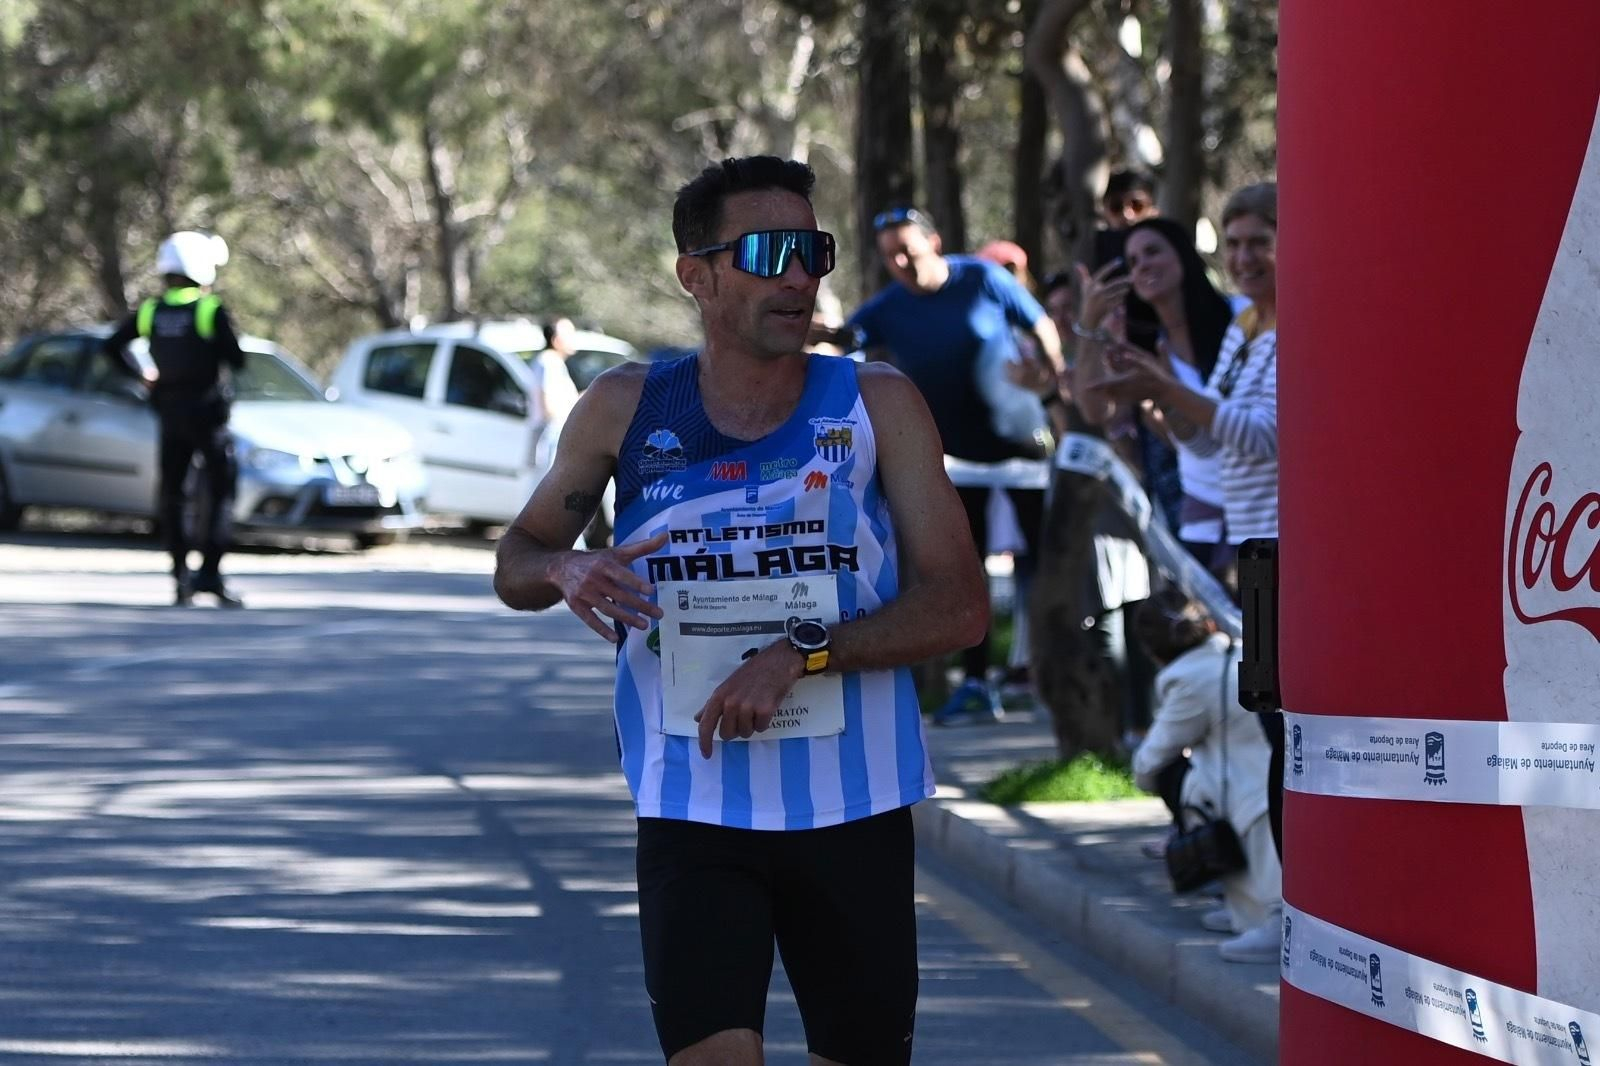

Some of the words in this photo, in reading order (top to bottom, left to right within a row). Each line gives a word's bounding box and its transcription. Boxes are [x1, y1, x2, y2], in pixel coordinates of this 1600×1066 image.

[669, 519, 825, 544] ATLETISMO
[646, 544, 860, 584] MÁLAGA
[692, 594, 739, 604] Ayuntamiento
[741, 594, 751, 602] de
[752, 592, 778, 602] Málaga
[785, 599, 817, 611] Málaga
[691, 624, 762, 634] www.deporte.malaga.eu
[774, 706, 809, 718] RATÓN
[1369, 735, 1394, 746] Deporte
[1396, 737, 1404, 747] de
[1404, 737, 1420, 749] Área
[1541, 741, 1567, 753] Deporte
[1569, 743, 1578, 753] de
[1579, 743, 1595, 756] Área
[1351, 752, 1361, 764] de
[1362, 751, 1420, 766] Ayuntamiento
[1486, 754, 1518, 771] Málaga
[1520, 758, 1531, 770] de
[1533, 757, 1595, 773] Ayuntamiento
